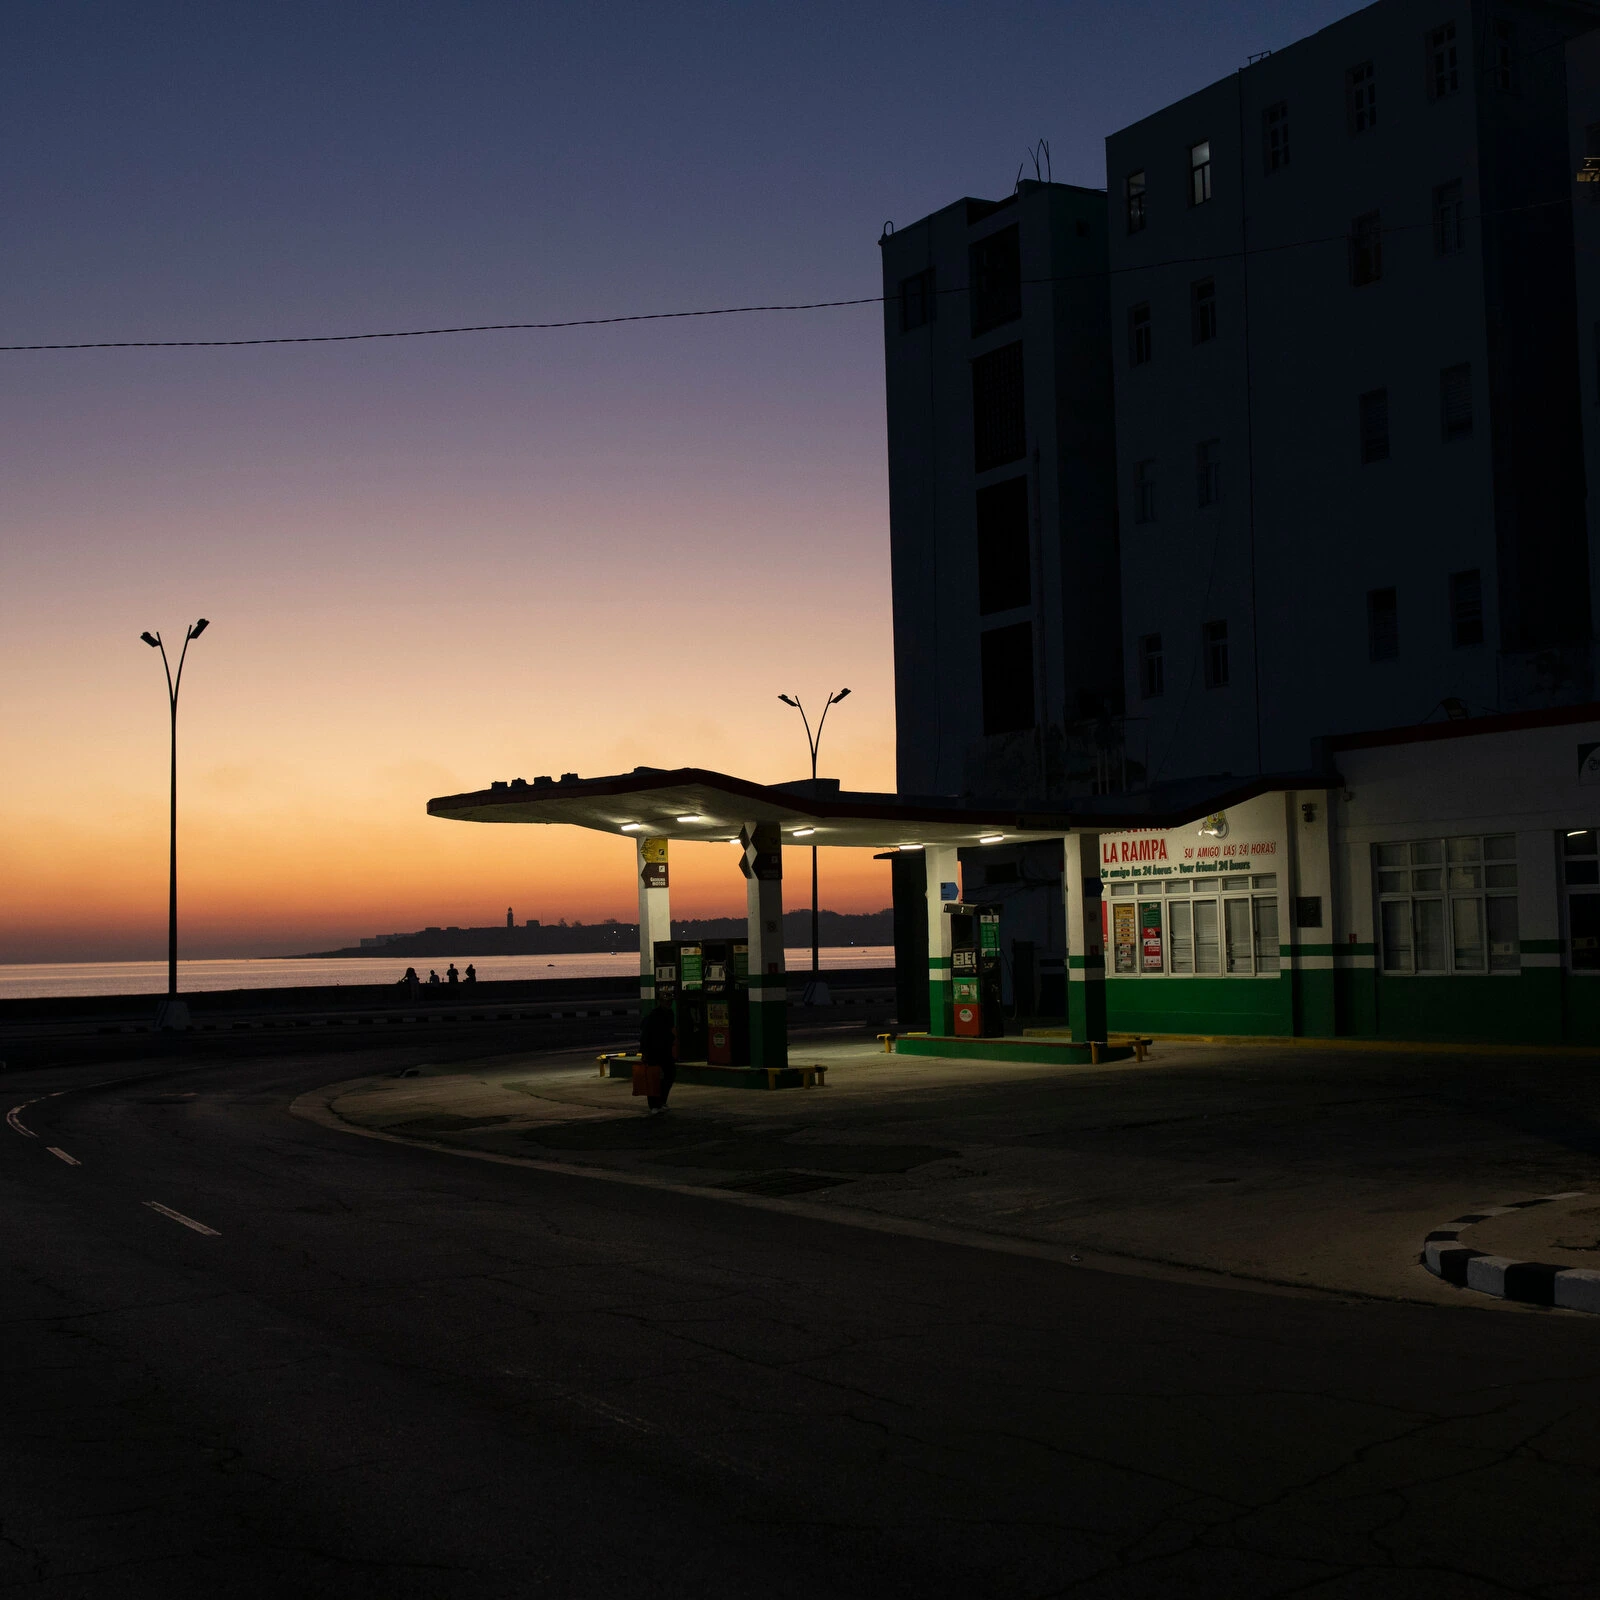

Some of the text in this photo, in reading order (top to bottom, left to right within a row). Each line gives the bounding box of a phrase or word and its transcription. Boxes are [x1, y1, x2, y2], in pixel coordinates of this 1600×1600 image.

[1103, 838, 1167, 863] LA RAMPA
[1184, 848, 1193, 858] SU
[1197, 846, 1219, 858] AMIGO
[1223, 845, 1235, 856] LAS
[1239, 844, 1248, 855] 24
[1101, 868, 1109, 878] Su
[1110, 867, 1130, 879] amigo
[1131, 866, 1141, 876] las
[1142, 865, 1152, 876] 24
[1179, 863, 1194, 873] Your
[1195, 861, 1217, 872] friend
[1218, 860, 1228, 871] 24
